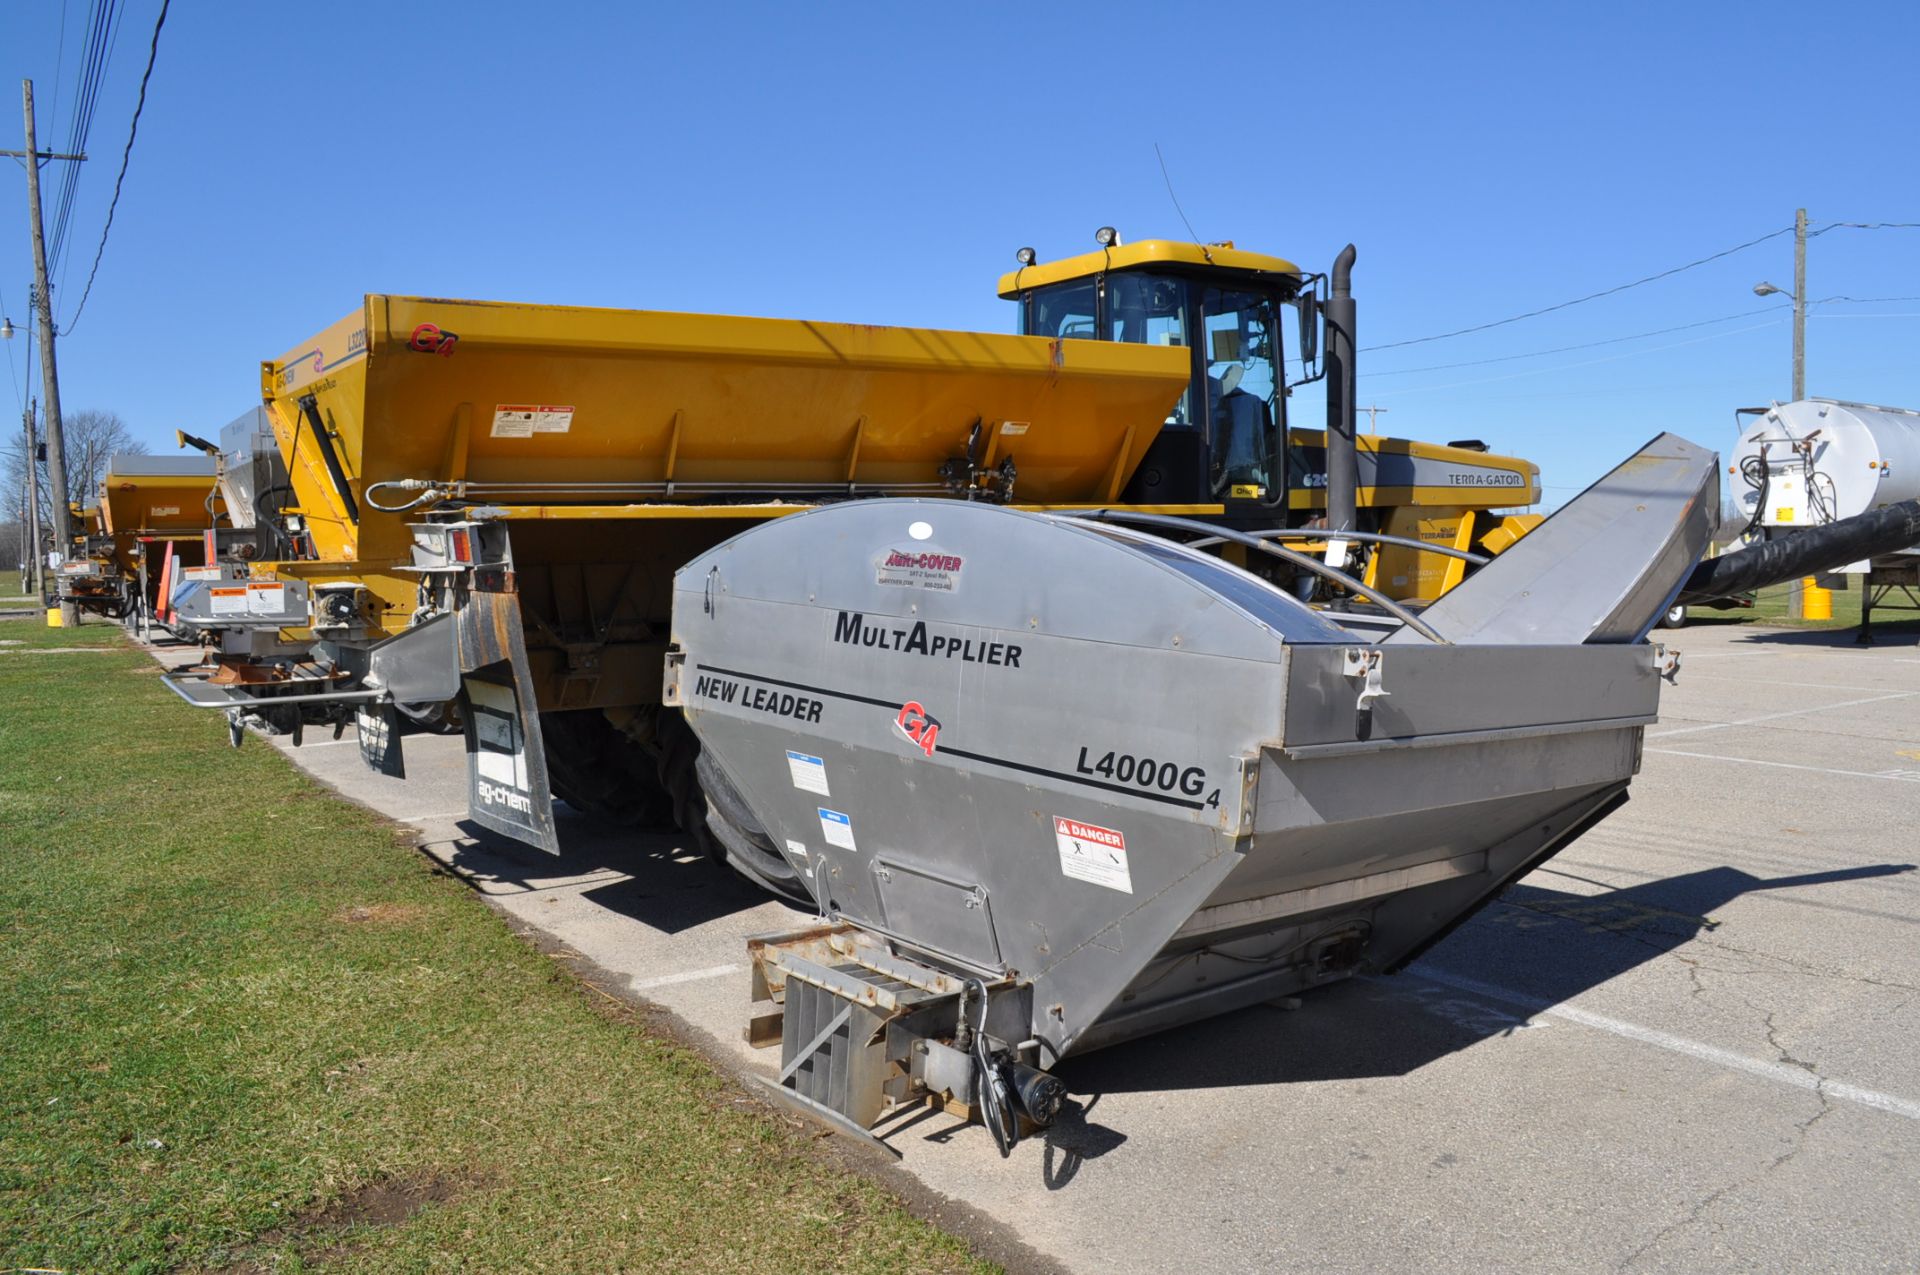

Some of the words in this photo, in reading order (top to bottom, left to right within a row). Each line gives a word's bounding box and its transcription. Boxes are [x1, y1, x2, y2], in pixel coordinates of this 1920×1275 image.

[411, 323, 456, 358] G4
[1448, 474, 1520, 485] TERRA-GATOR
[696, 676, 738, 703] NEW
[741, 686, 824, 723] LEADER
[1071, 824, 1122, 846] DANGER
